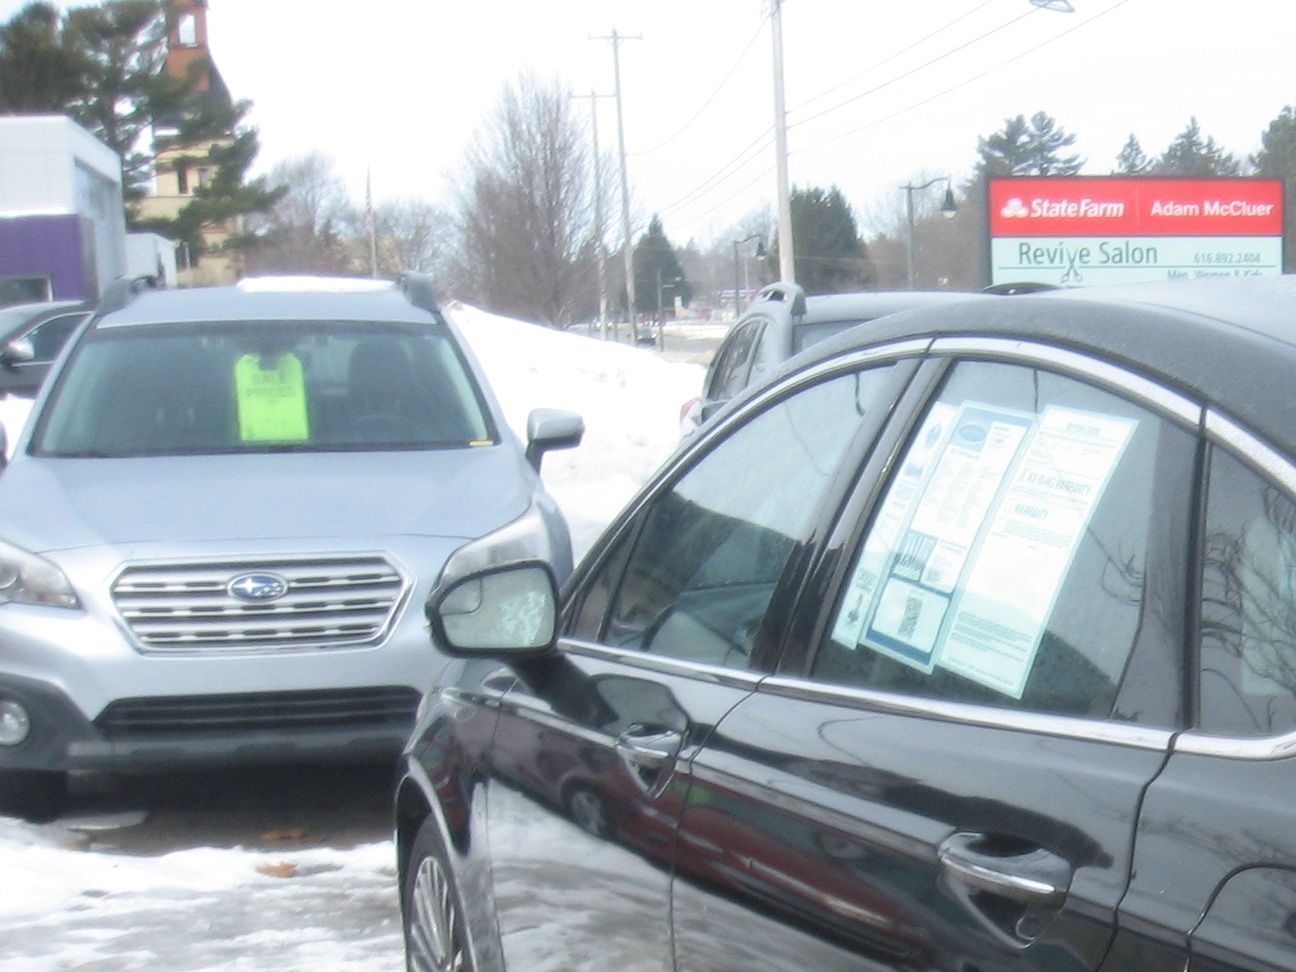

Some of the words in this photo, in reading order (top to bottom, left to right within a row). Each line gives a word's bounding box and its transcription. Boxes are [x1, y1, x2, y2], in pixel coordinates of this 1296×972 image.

[1150, 200, 1200, 217] Adam
[1203, 200, 1274, 217] McCluer
[1018, 241, 1091, 265] Revive
[1098, 240, 1158, 265] Salon
